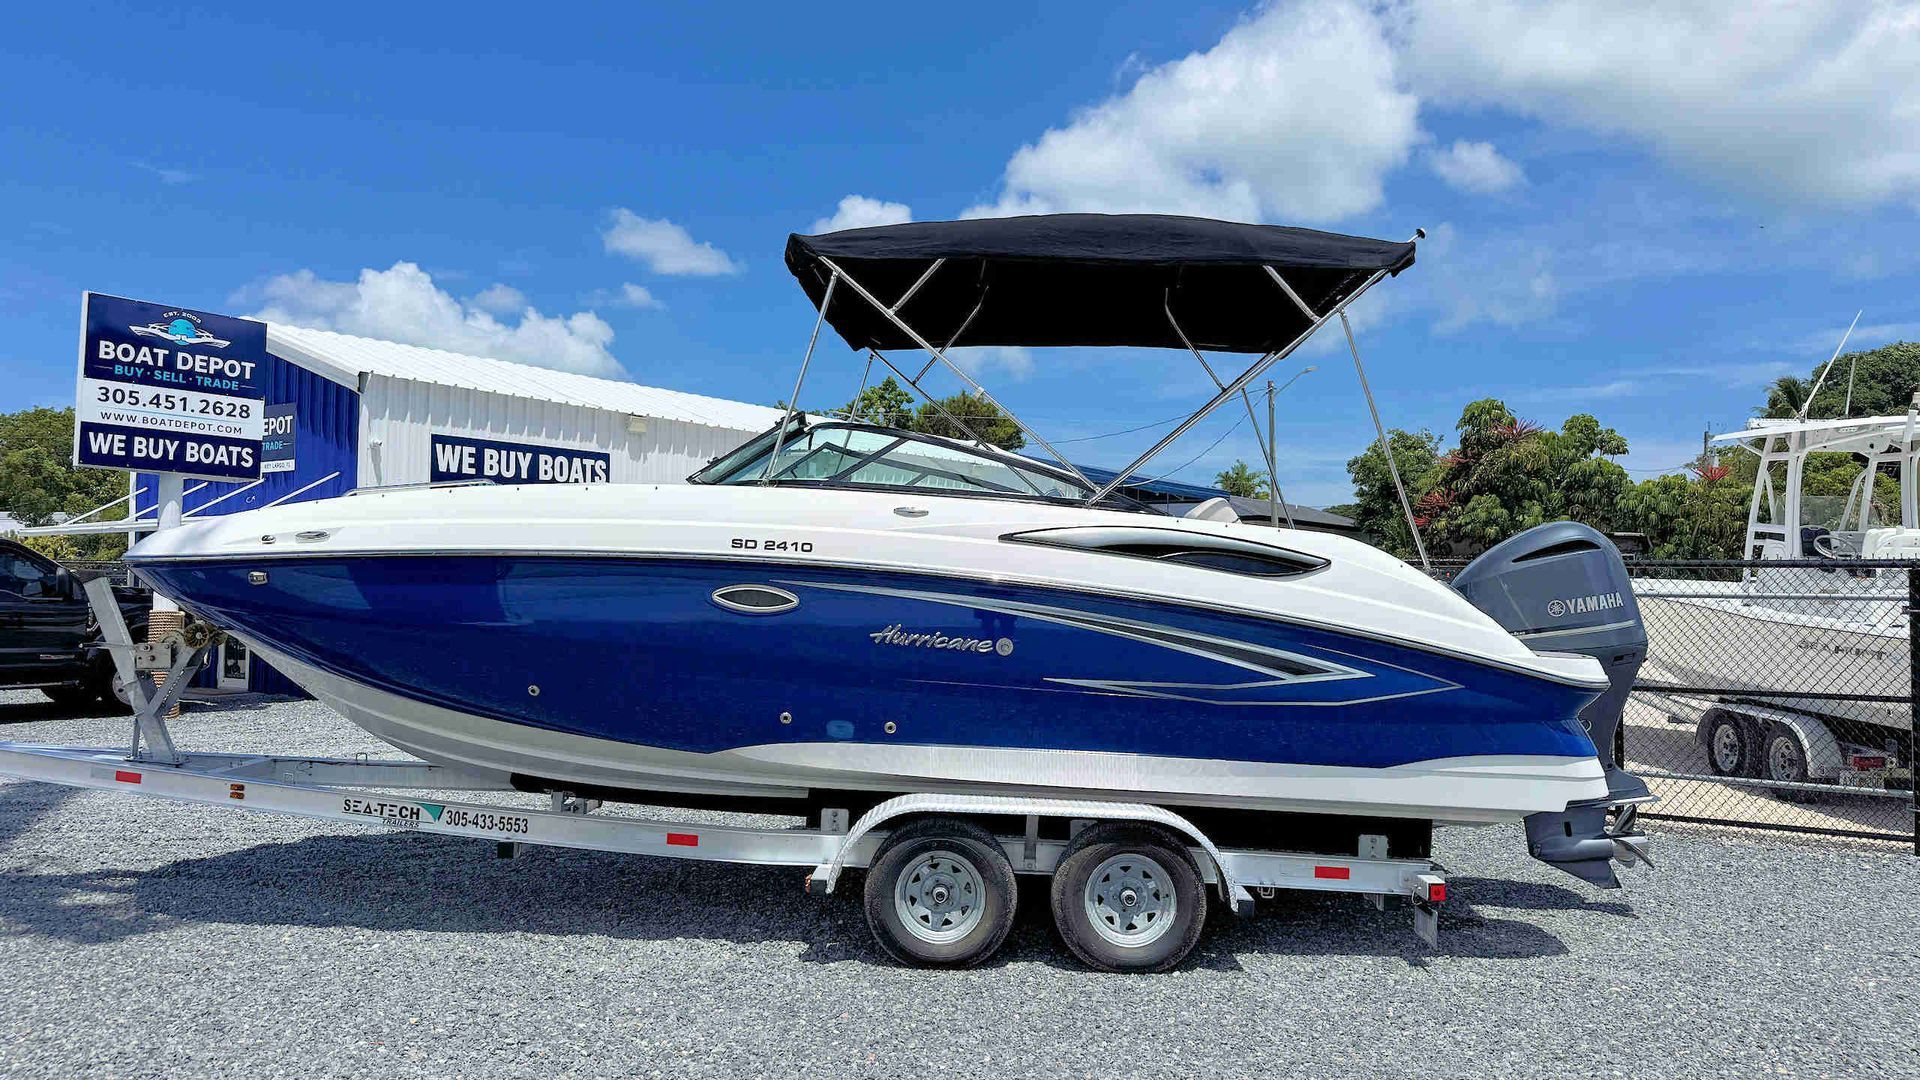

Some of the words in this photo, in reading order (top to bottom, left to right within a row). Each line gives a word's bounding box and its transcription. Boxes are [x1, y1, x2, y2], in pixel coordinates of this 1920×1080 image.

[99, 340, 169, 367] BOAT
[176, 352, 256, 380] DEPOT
[114, 364, 144, 378] BUY
[153, 370, 187, 384] SELL
[196, 375, 239, 391] TRADE
[97, 386, 251, 419] 305.451.2628
[100, 411, 242, 434] WWW.BOATDEPOT.COM
[263, 415, 293, 436] EPOT
[88, 431, 127, 456] WE
[133, 436, 180, 461] BUY
[185, 441, 254, 468] BOATS
[435, 443, 476, 475] WE
[483, 448, 533, 479] BUY
[538, 454, 607, 484] BOATS
[731, 538, 757, 549] SD
[764, 540, 813, 553] 2410
[1565, 591, 1624, 614] YAMAHA
[869, 623, 994, 653] Hurricane
[343, 798, 420, 820] SEA-TECH
[382, 818, 420, 828] TRAILERS
[446, 810, 528, 834] 305-433-5553
